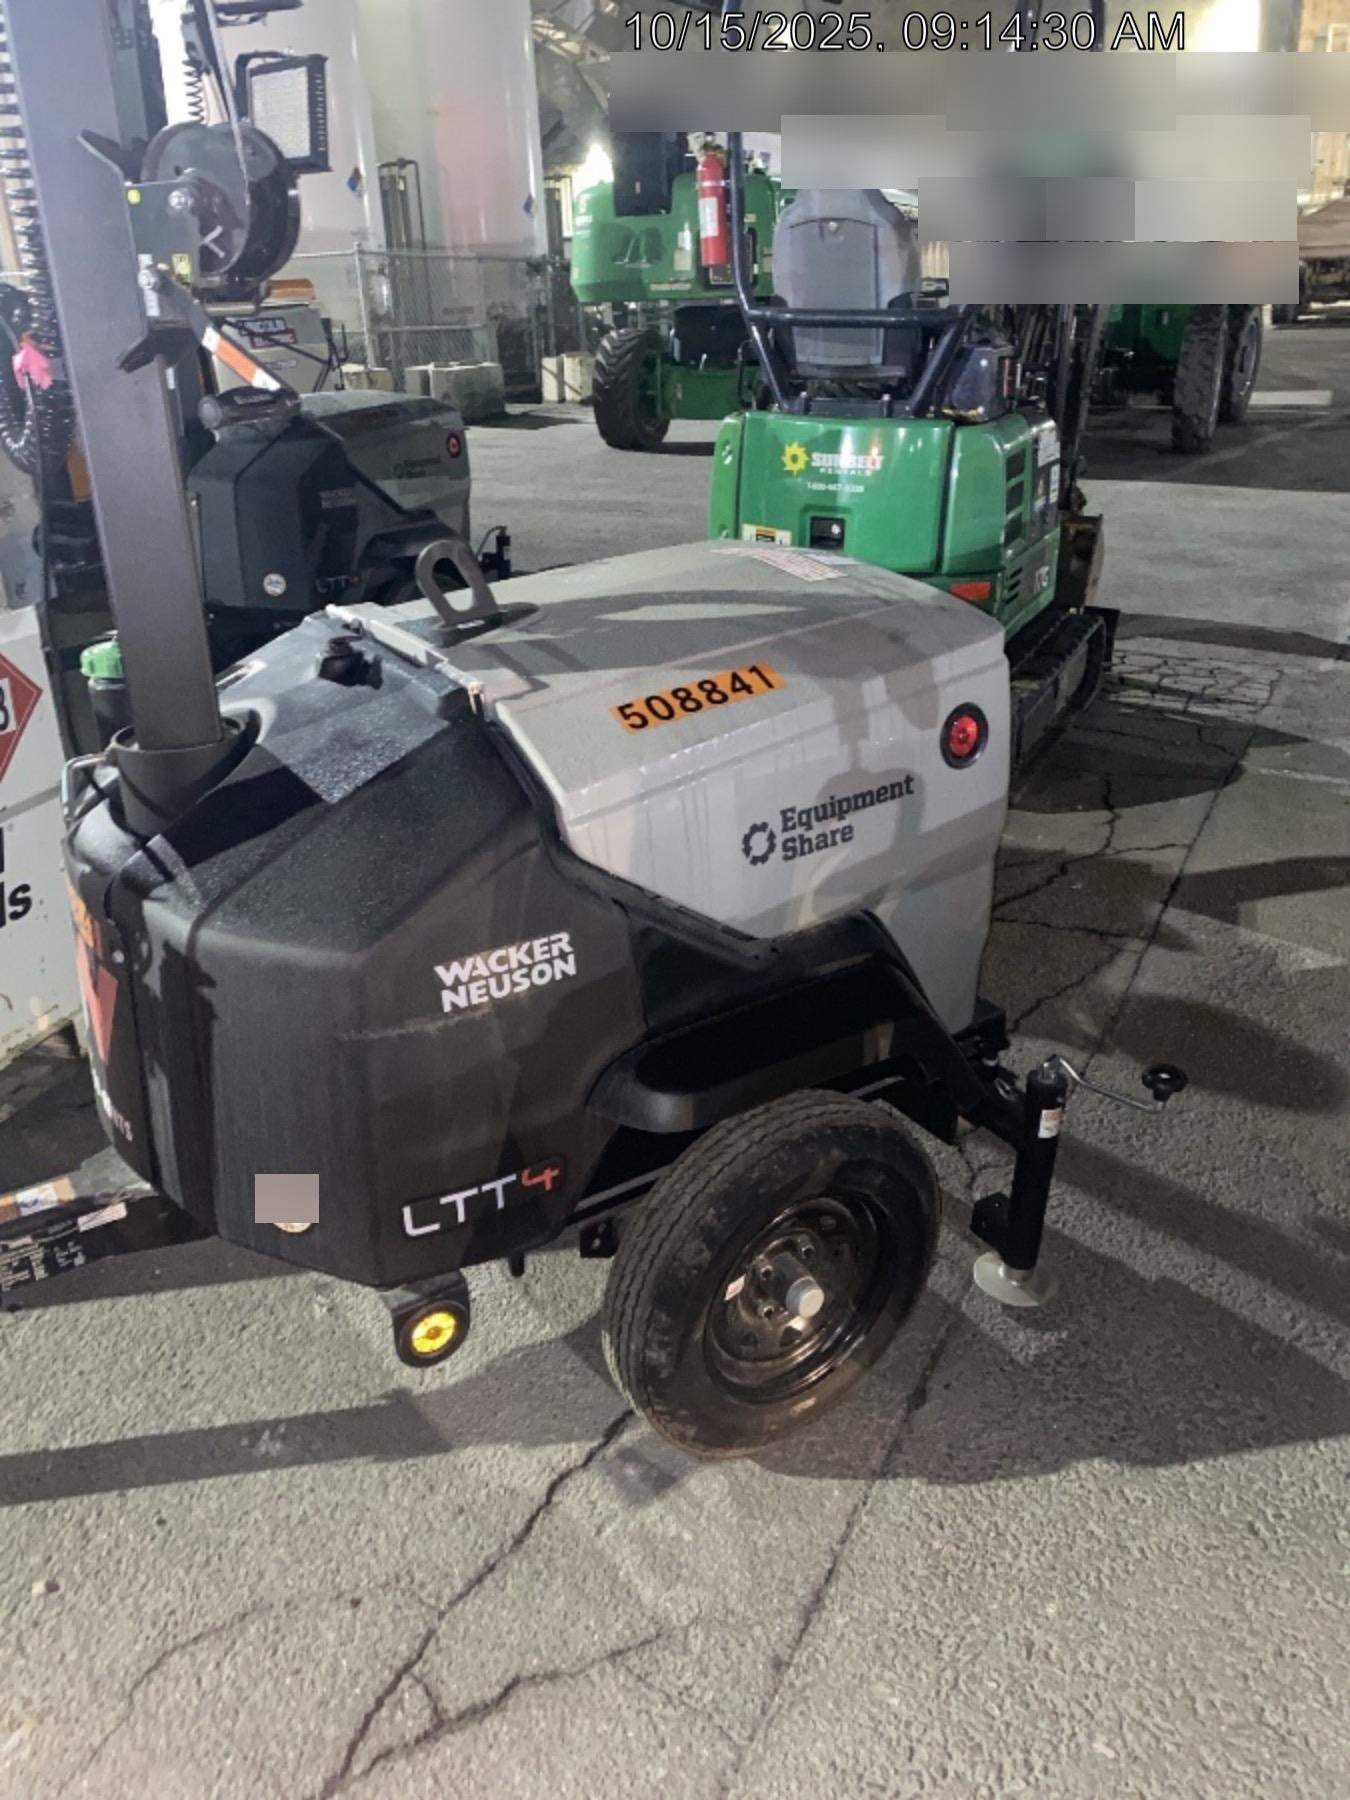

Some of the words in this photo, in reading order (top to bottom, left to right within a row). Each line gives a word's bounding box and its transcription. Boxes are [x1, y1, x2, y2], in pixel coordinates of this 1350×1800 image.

[811, 452, 884, 470] SUBELT
[616, 664, 775, 730] 508841
[780, 774, 915, 833] Equipment
[781, 824, 855, 862] Share
[433, 931, 574, 987] WACKER
[440, 953, 577, 1014] NEUSON
[402, 1167, 560, 1237] LTT4
